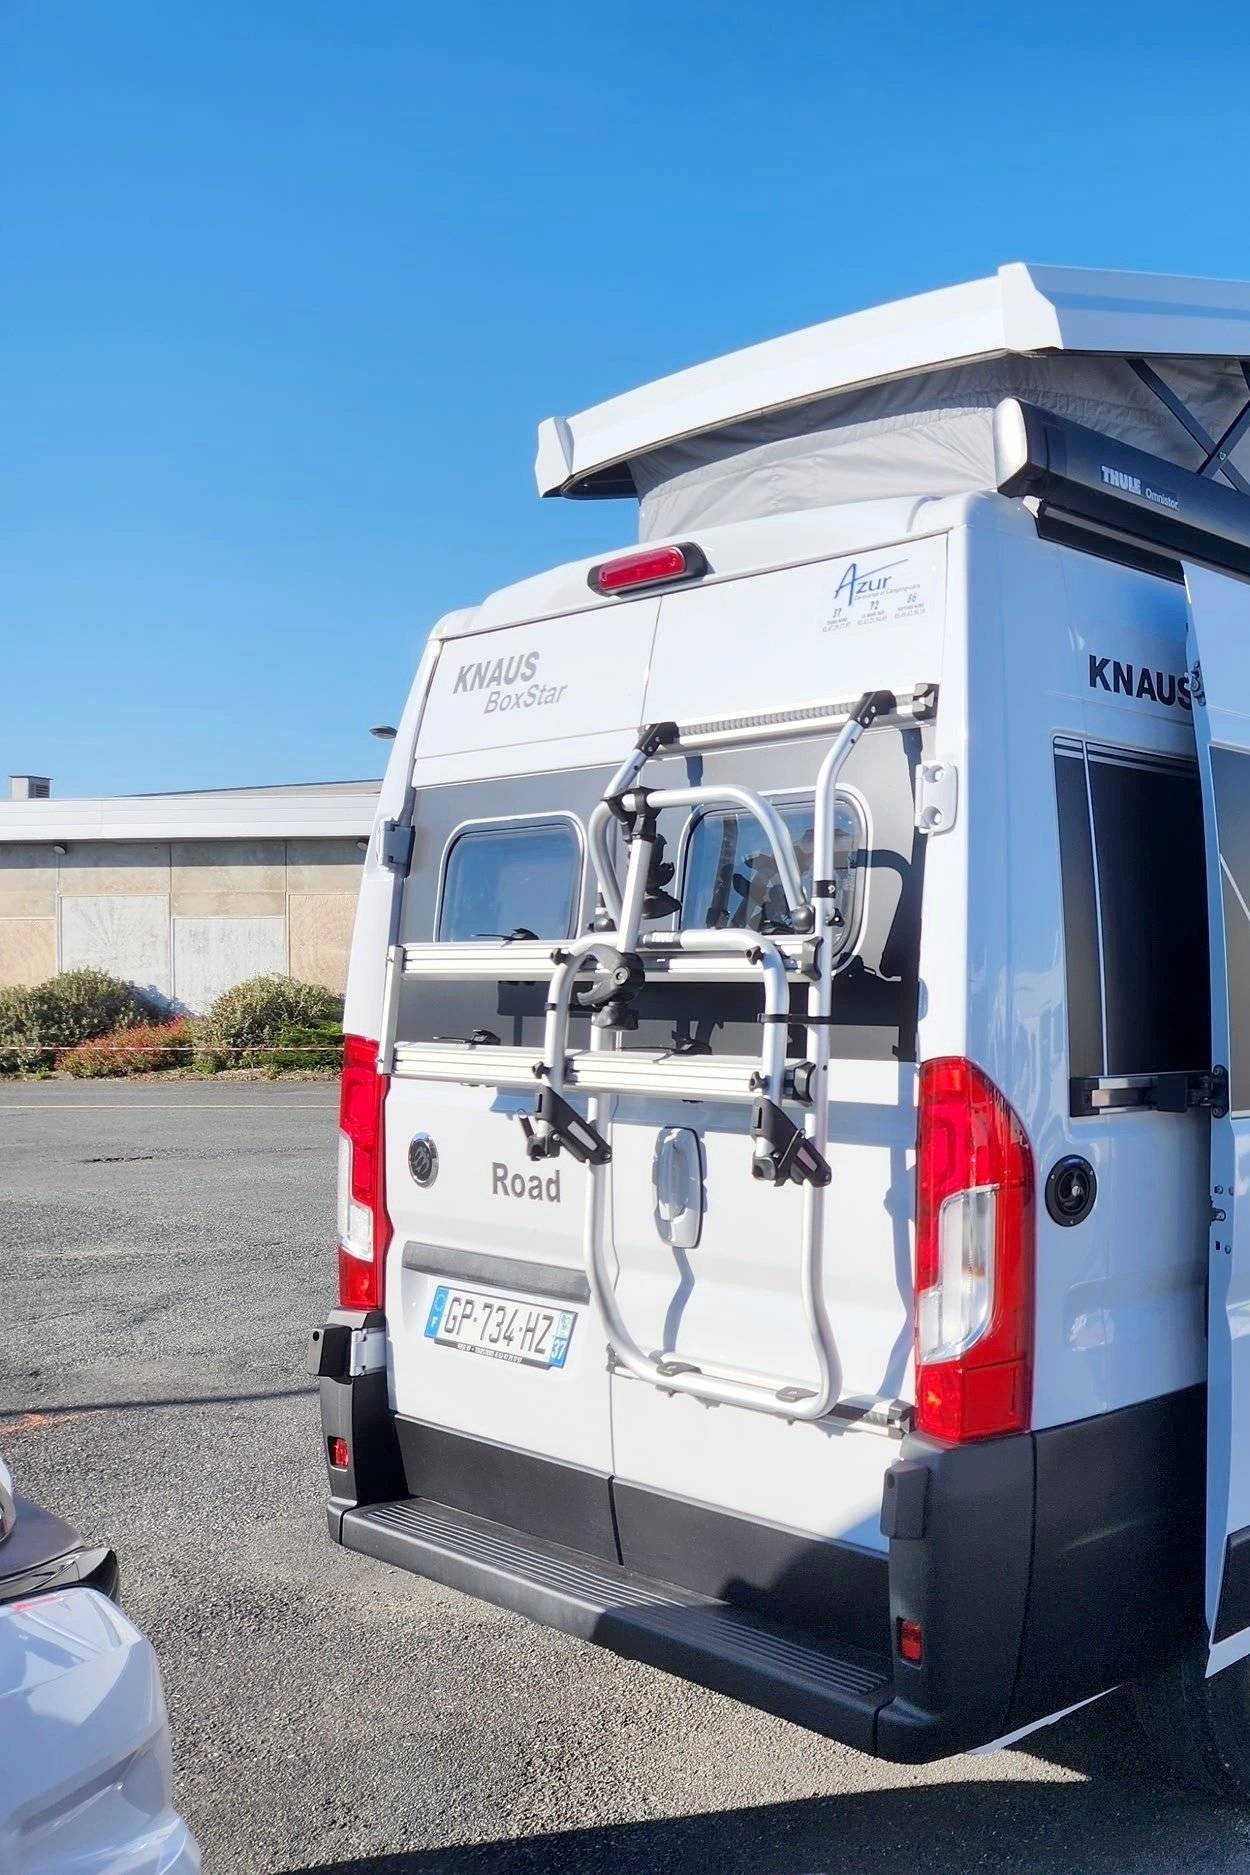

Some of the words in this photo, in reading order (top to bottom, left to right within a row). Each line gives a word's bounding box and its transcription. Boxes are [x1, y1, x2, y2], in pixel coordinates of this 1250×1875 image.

[1101, 465, 1141, 495] THULE
[1145, 488, 1179, 510] Omnistor
[834, 560, 898, 606] Azur
[453, 651, 540, 695] KNAUS
[1089, 654, 1193, 711] KNAUS
[484, 684, 568, 714] BoxStar
[492, 1162, 561, 1203] Road
[444, 1296, 555, 1355] GP-734-HZ
[551, 1338, 567, 1361] 37
